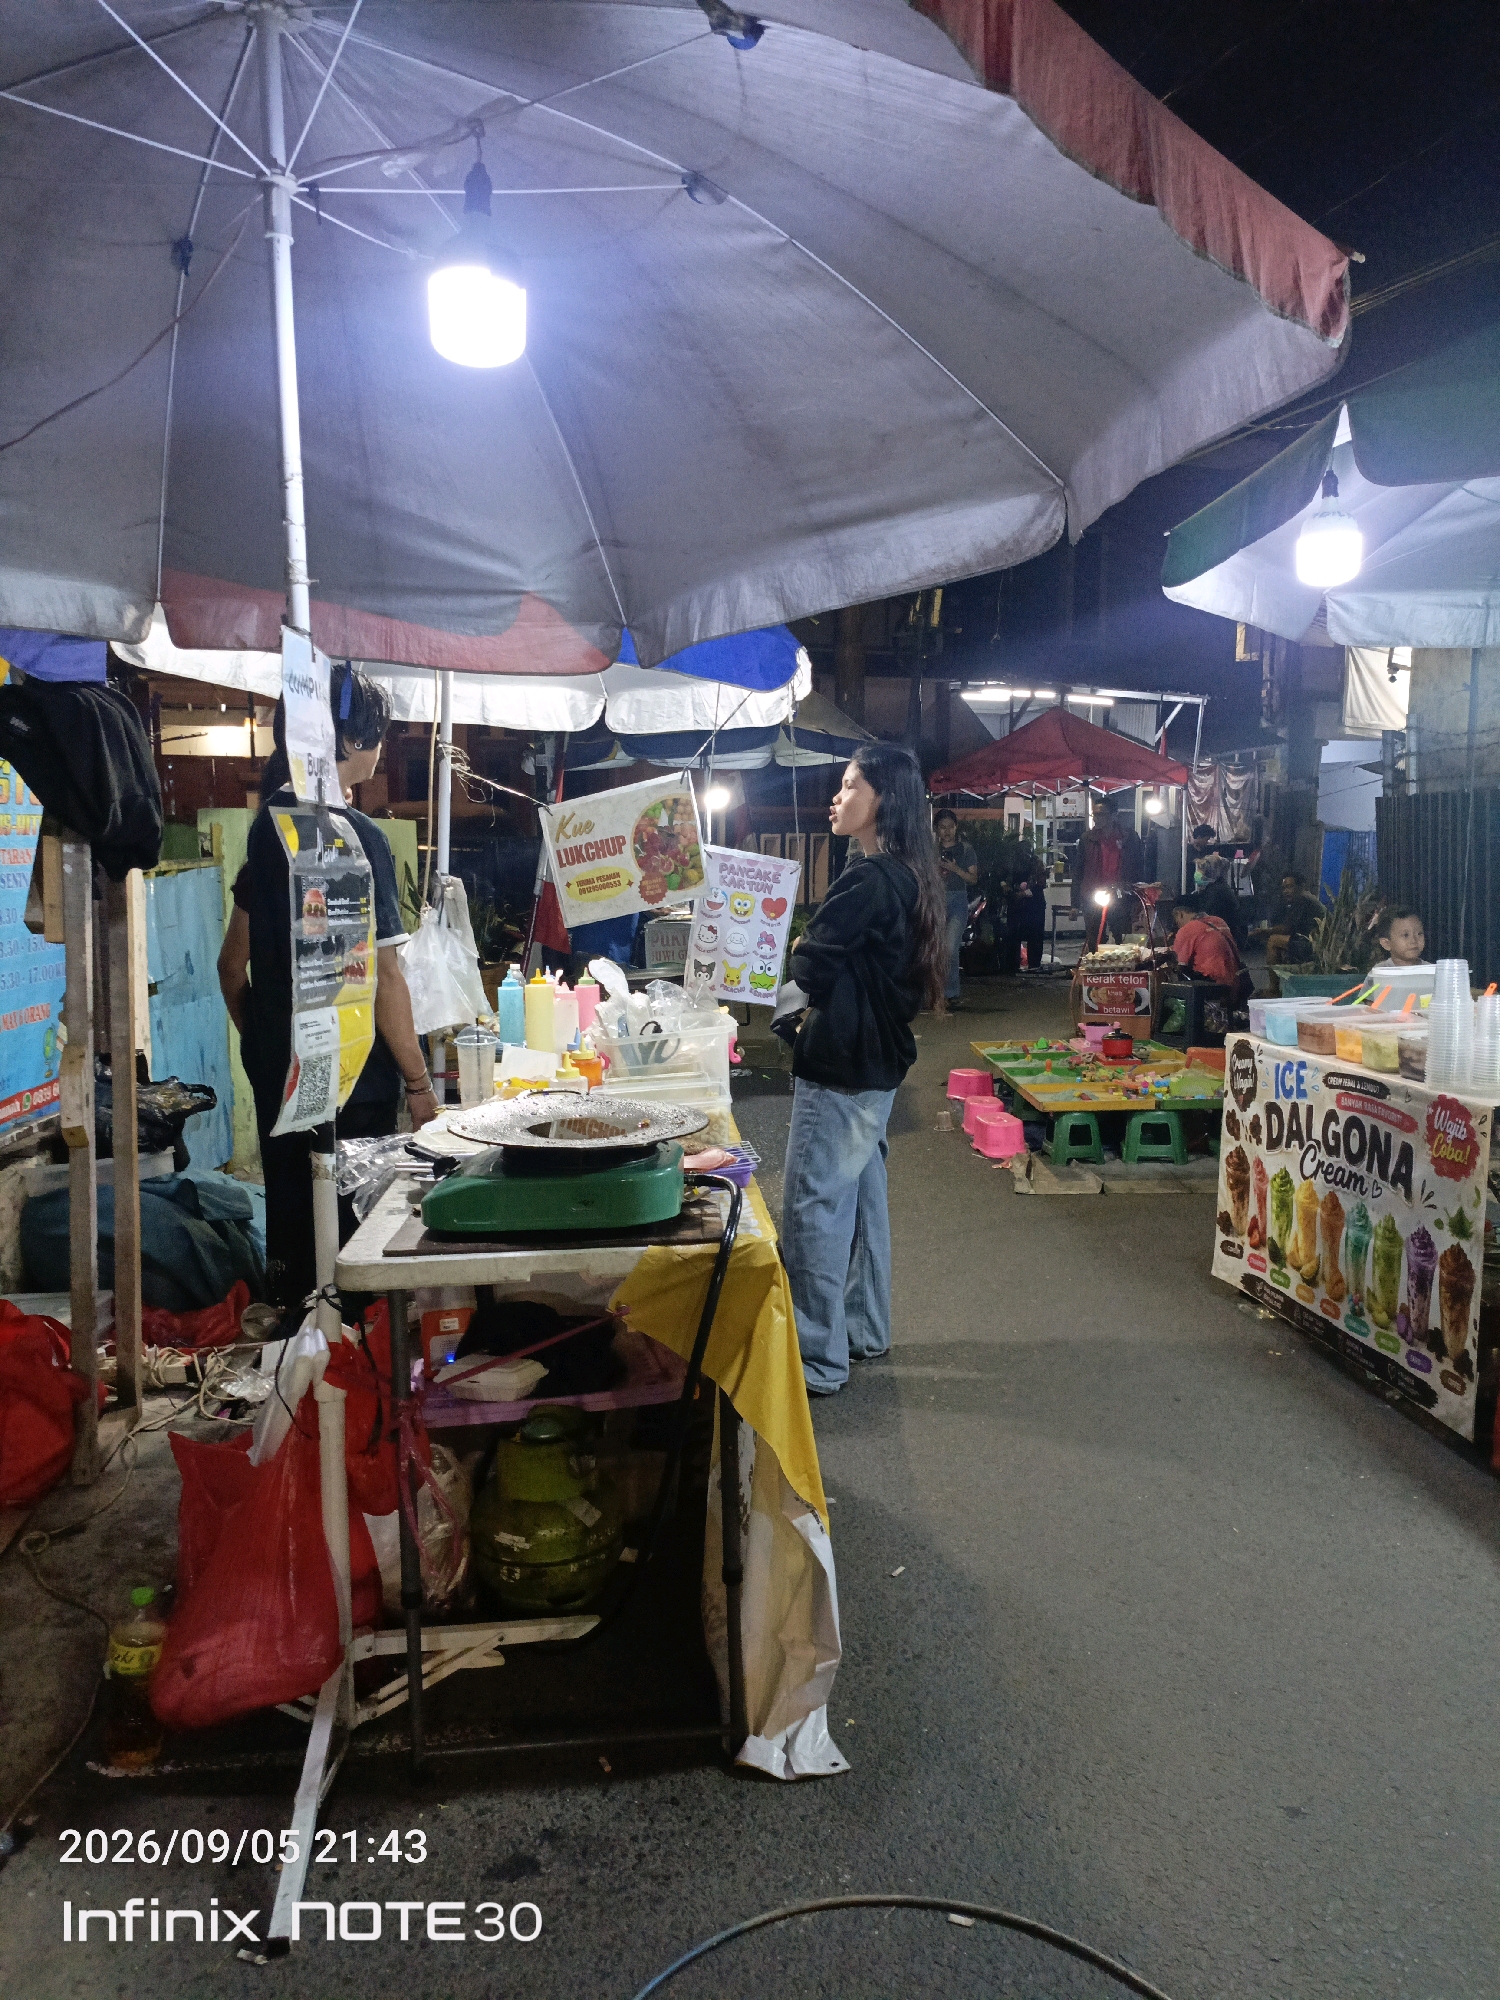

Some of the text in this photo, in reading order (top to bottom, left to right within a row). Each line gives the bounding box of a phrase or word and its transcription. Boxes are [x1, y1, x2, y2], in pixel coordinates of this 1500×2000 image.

[555, 812, 595, 844] Kue
[0, 849, 33, 865] TARAN
[555, 835, 627, 869] LUKCHUP
[576, 872, 621, 887] TERIMA PESANAN
[718, 863, 782, 884] PANCAKE
[719, 874, 774, 895] KARTUN
[1086, 974, 1145, 985] kerak telor
[1103, 1006, 1130, 1014] betawi
[1274, 1060, 1308, 1100] ICE
[1434, 1106, 1468, 1143] Wajib
[1265, 1101, 1414, 1202] DALGONA
[1432, 1133, 1471, 1165] Coba!
[1299, 1144, 1368, 1196] Cream
